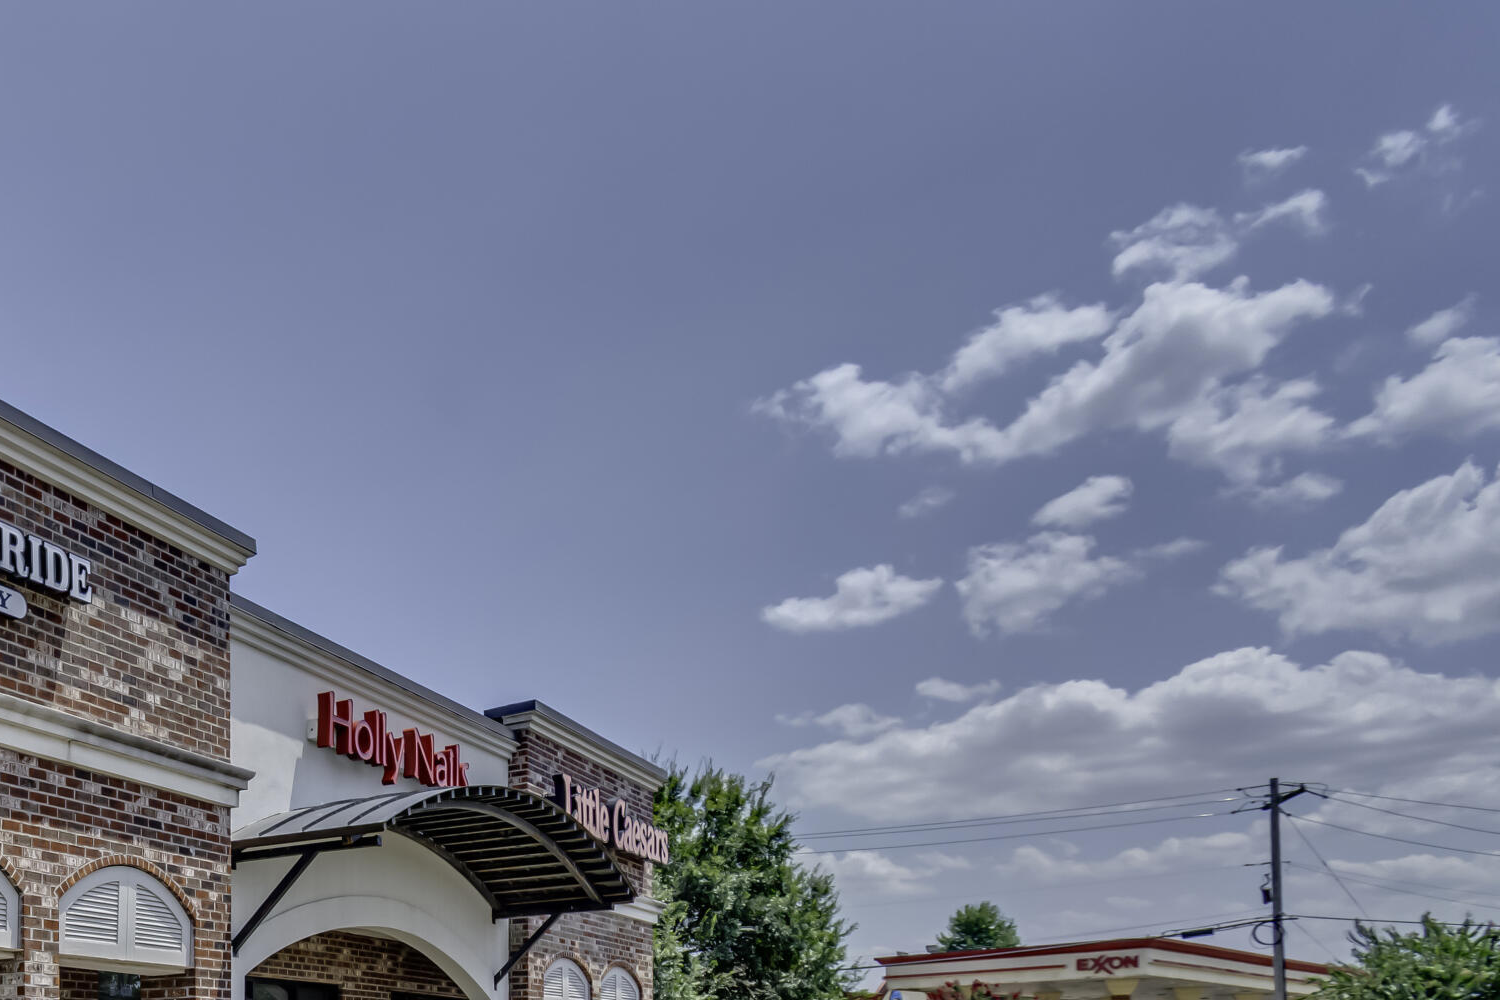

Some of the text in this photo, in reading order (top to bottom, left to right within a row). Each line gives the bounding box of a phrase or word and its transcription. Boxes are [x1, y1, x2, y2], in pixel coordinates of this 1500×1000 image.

[317, 690, 404, 786] Holly
[554, 772, 669, 865] Little Caesars
[1076, 954, 1139, 975] EXXON
